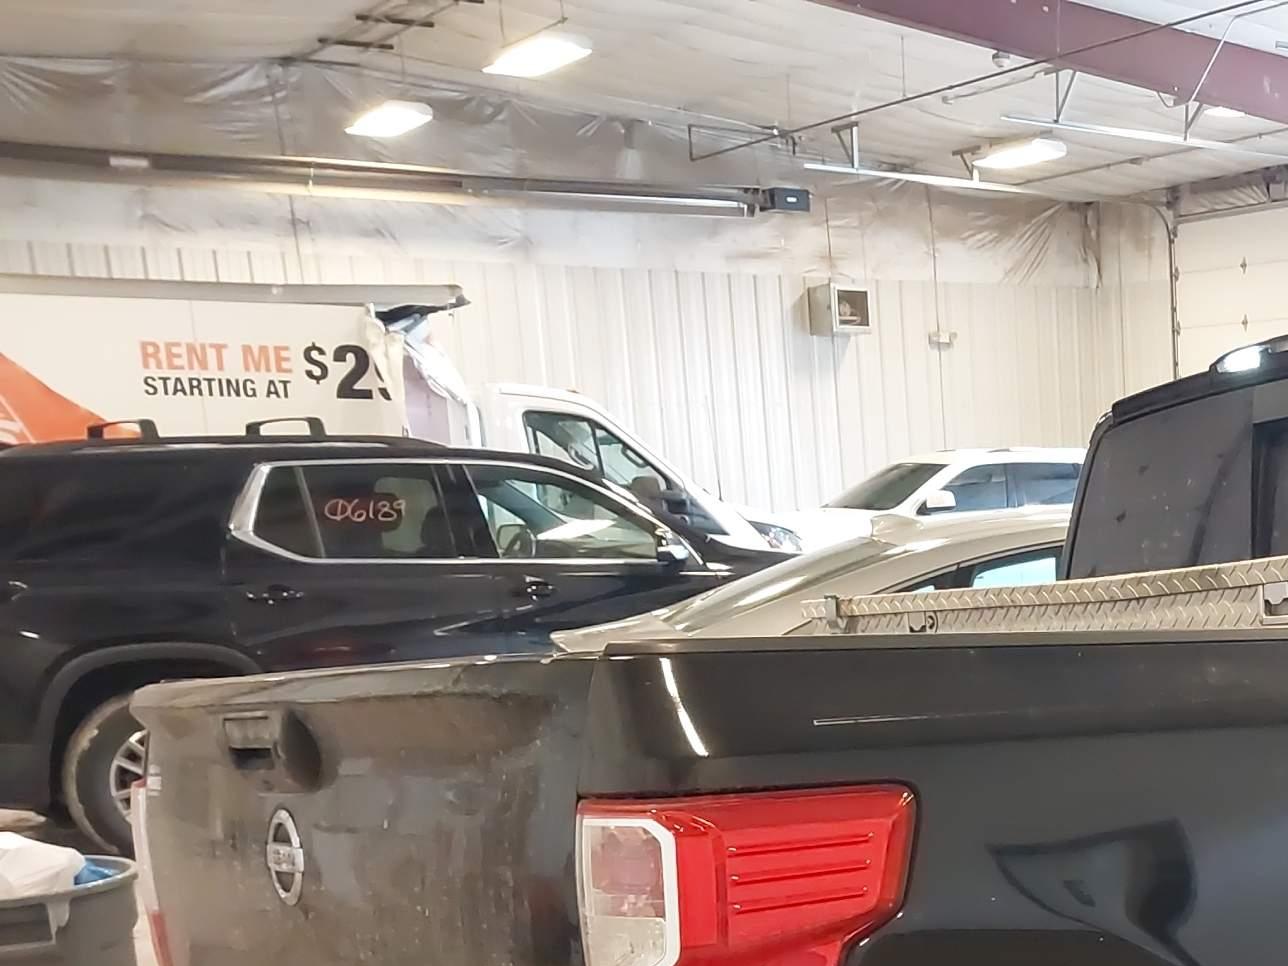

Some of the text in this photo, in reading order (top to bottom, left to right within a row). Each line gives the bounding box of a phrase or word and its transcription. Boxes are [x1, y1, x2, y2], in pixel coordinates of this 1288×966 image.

[139, 340, 293, 374] RENT ME
[144, 376, 292, 399] STARTING AT
